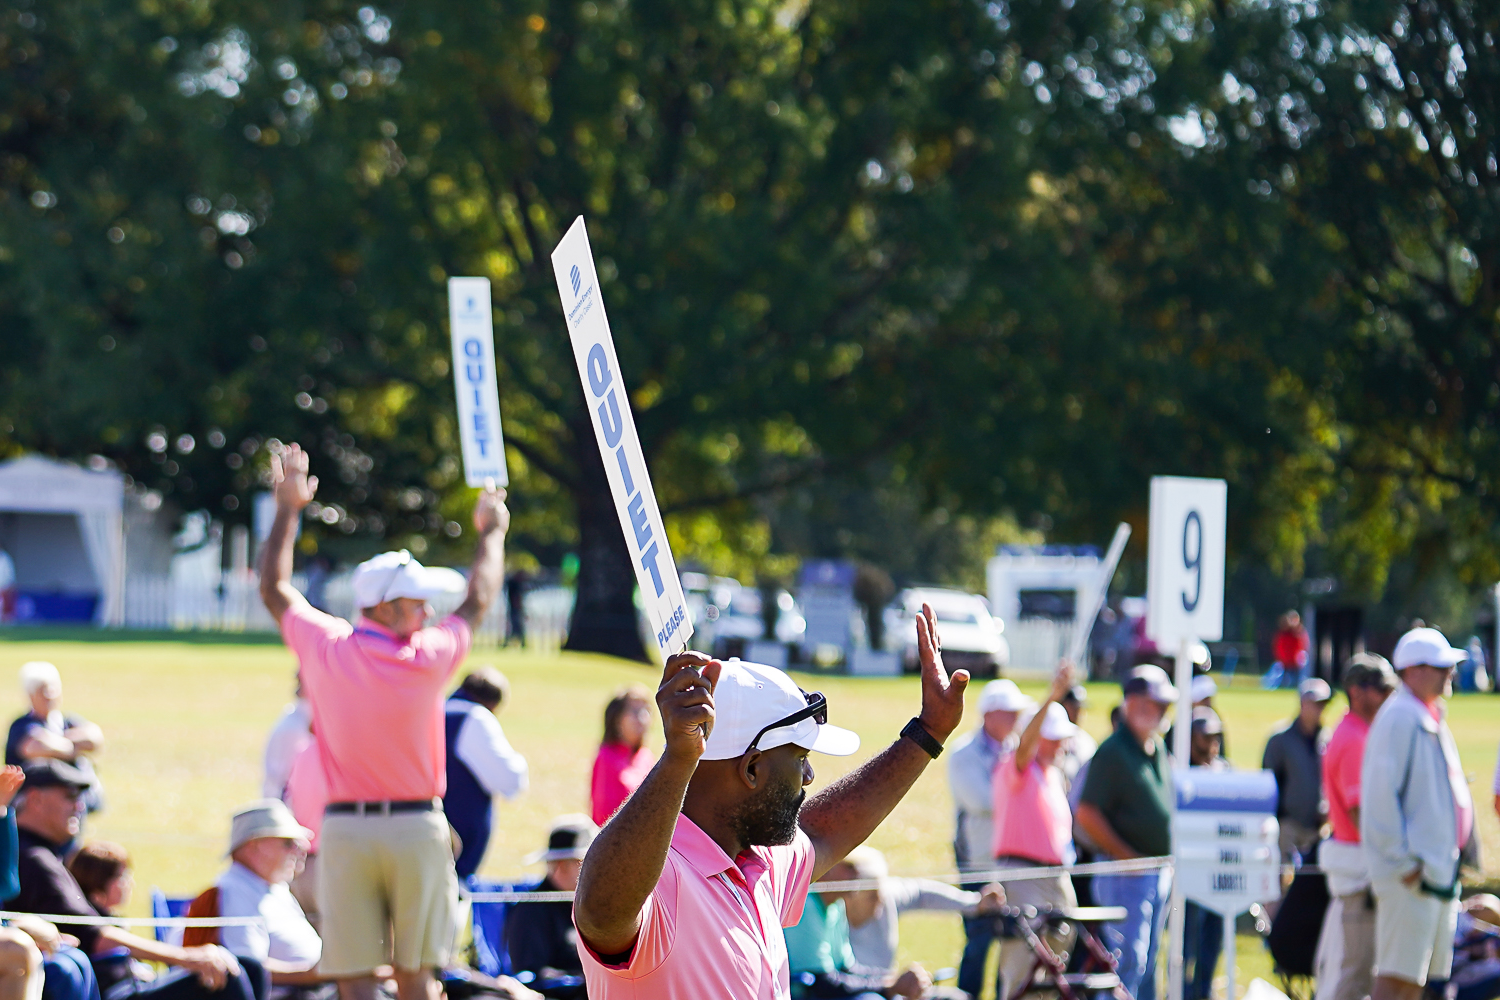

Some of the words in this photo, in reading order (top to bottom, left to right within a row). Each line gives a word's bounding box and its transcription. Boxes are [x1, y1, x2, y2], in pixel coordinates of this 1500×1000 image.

[464, 338, 490, 458] QUIET
[587, 342, 664, 598] QUIET
[1182, 510, 1202, 612] 9
[657, 605, 685, 648] PLEASE
